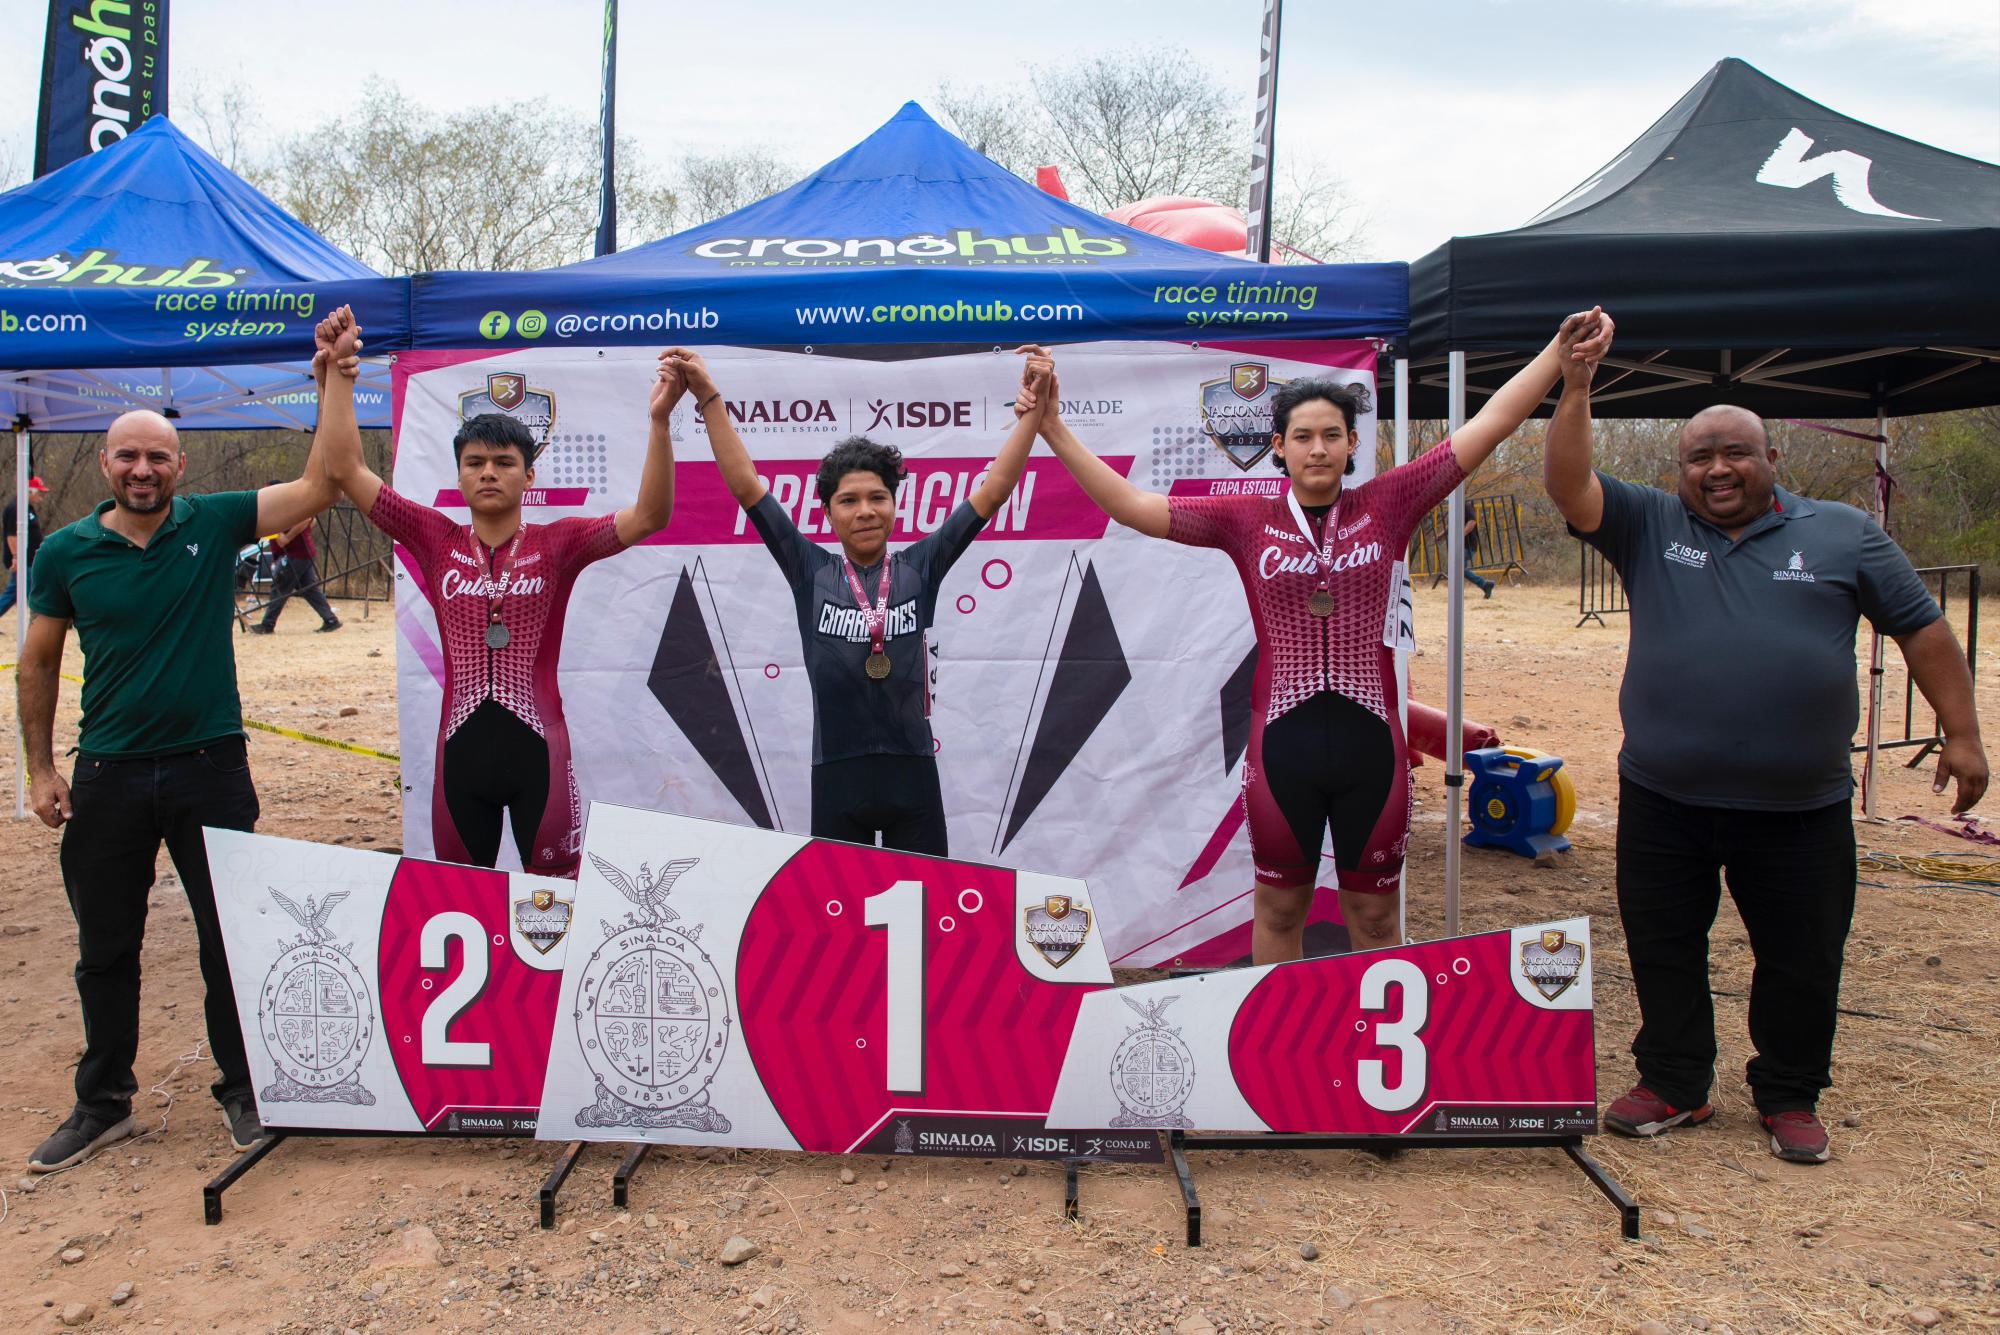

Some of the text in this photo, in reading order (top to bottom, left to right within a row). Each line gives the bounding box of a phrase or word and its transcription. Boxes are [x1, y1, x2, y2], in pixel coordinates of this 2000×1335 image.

[143, 2, 157, 45] pas
[695, 228, 1127, 258] cronohub
[730, 256, 1089, 266] medimos tu pasión
[155, 289, 315, 318] race timing
[1153, 280, 1318, 310] race timing
[0, 310, 87, 333] b.com
[555, 307, 720, 338] @cronohub
[796, 300, 1083, 326] www.cronohub.com
[1185, 307, 1289, 328] system
[183, 320, 286, 342] system
[694, 399, 837, 423] SNALOA
[898, 401, 971, 428] ISDE
[1058, 400, 1123, 415] ONADE
[1202, 406, 1274, 418] NACIONAL
[793, 425, 838, 433] ESTADO
[1202, 418, 1274, 436] CONAD
[1228, 437, 1263, 445] 2024
[1209, 480, 1282, 496] ETAPA ESTATAL
[1264, 524, 1305, 544] IMDEC
[1258, 541, 1383, 580] Culicán
[1679, 545, 1708, 562] ISDE
[498, 570, 511, 592] ISDE
[1772, 570, 1815, 580] SINALOA
[876, 596, 887, 616] ISDE
[863, 608, 878, 628] ISDE
[619, 934, 685, 953] SINALOA
[1025, 932, 1086, 944] CONADE
[291, 950, 340, 965] SINALOA
[1521, 965, 1579, 977] CONADE
[420, 911, 491, 1065] 2
[864, 880, 924, 1093] 1
[1136, 1032, 1172, 1042] SINALOA
[1357, 959, 1429, 1112] 3
[303, 1073, 332, 1081] 1831
[635, 1090, 672, 1101] 1831
[461, 1118, 537, 1129] SINALOA ISD
[1450, 1117, 1499, 1126] SINALOA
[1518, 1118, 1545, 1129] ISDE
[919, 1132, 996, 1147] SINALOA
[1105, 1139, 1151, 1150] CONADE
